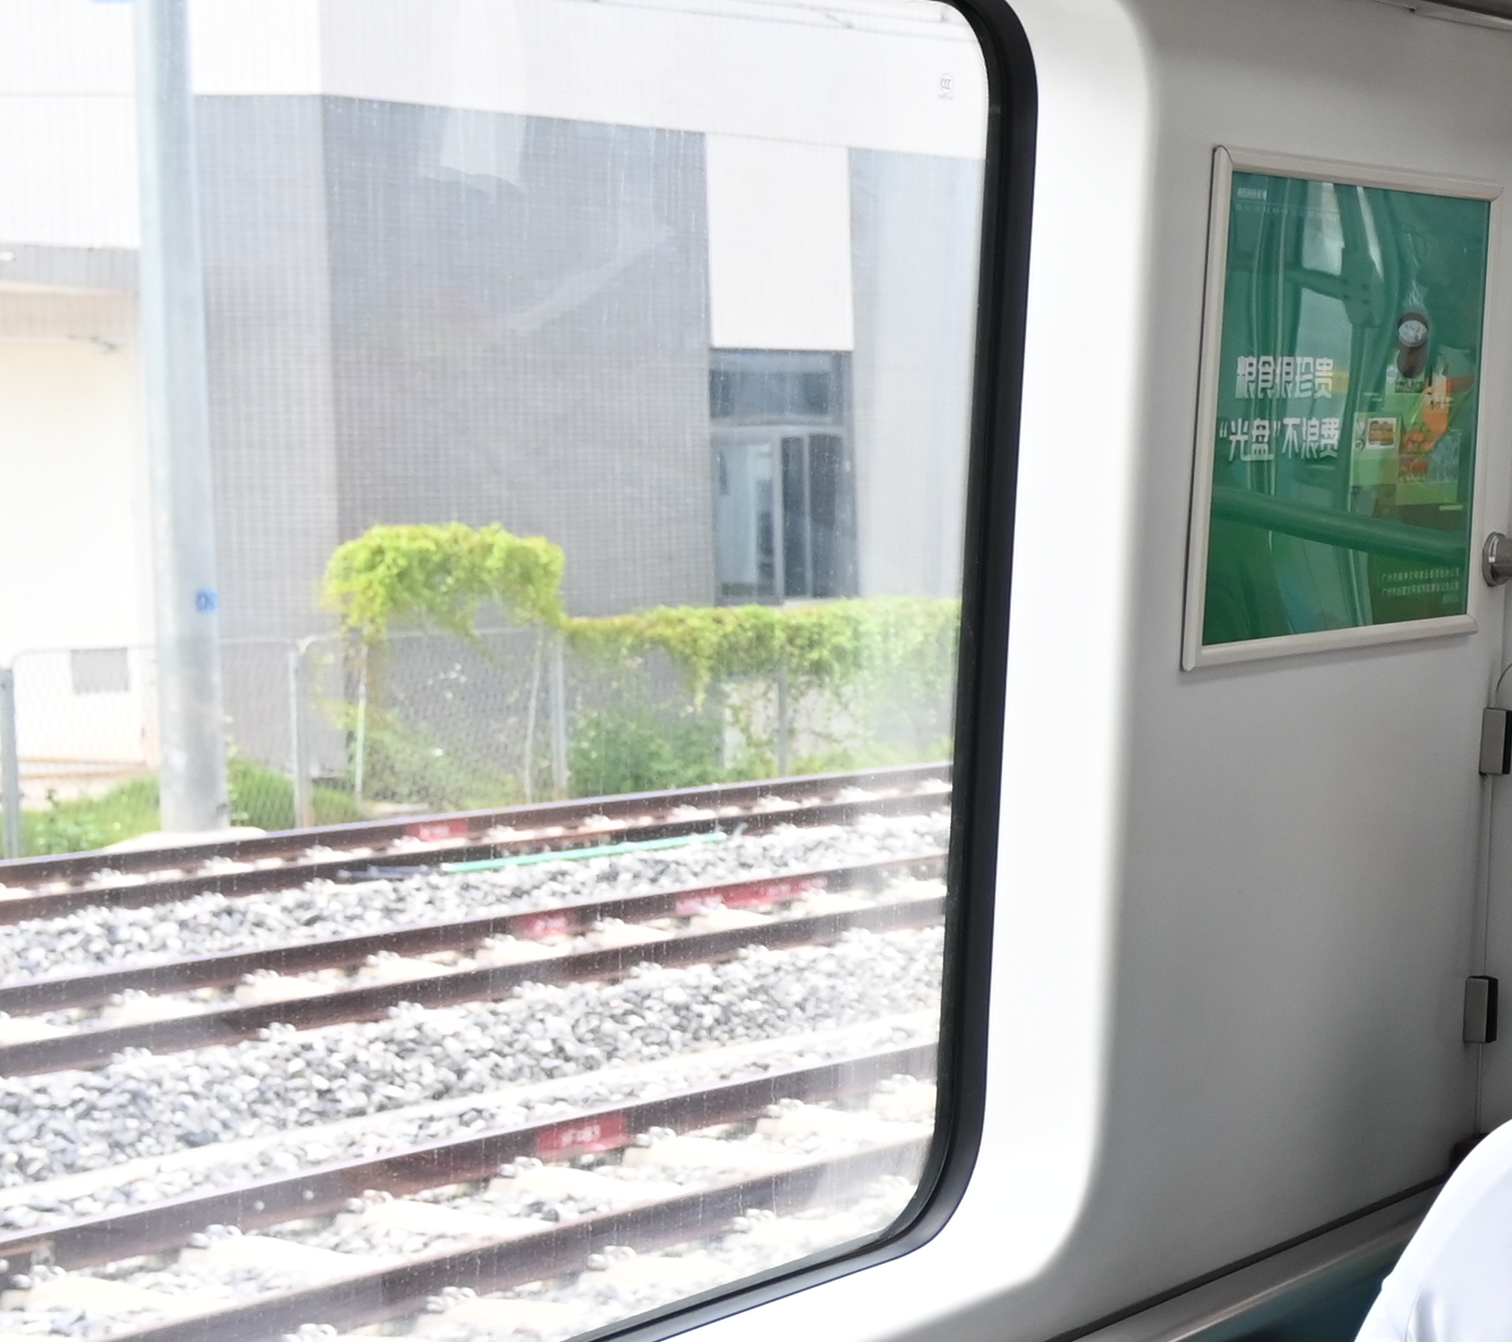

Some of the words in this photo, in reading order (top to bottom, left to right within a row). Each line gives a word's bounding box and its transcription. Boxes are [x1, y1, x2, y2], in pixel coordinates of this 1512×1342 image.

[1235, 355, 1334, 399] 粮食很珍贵
